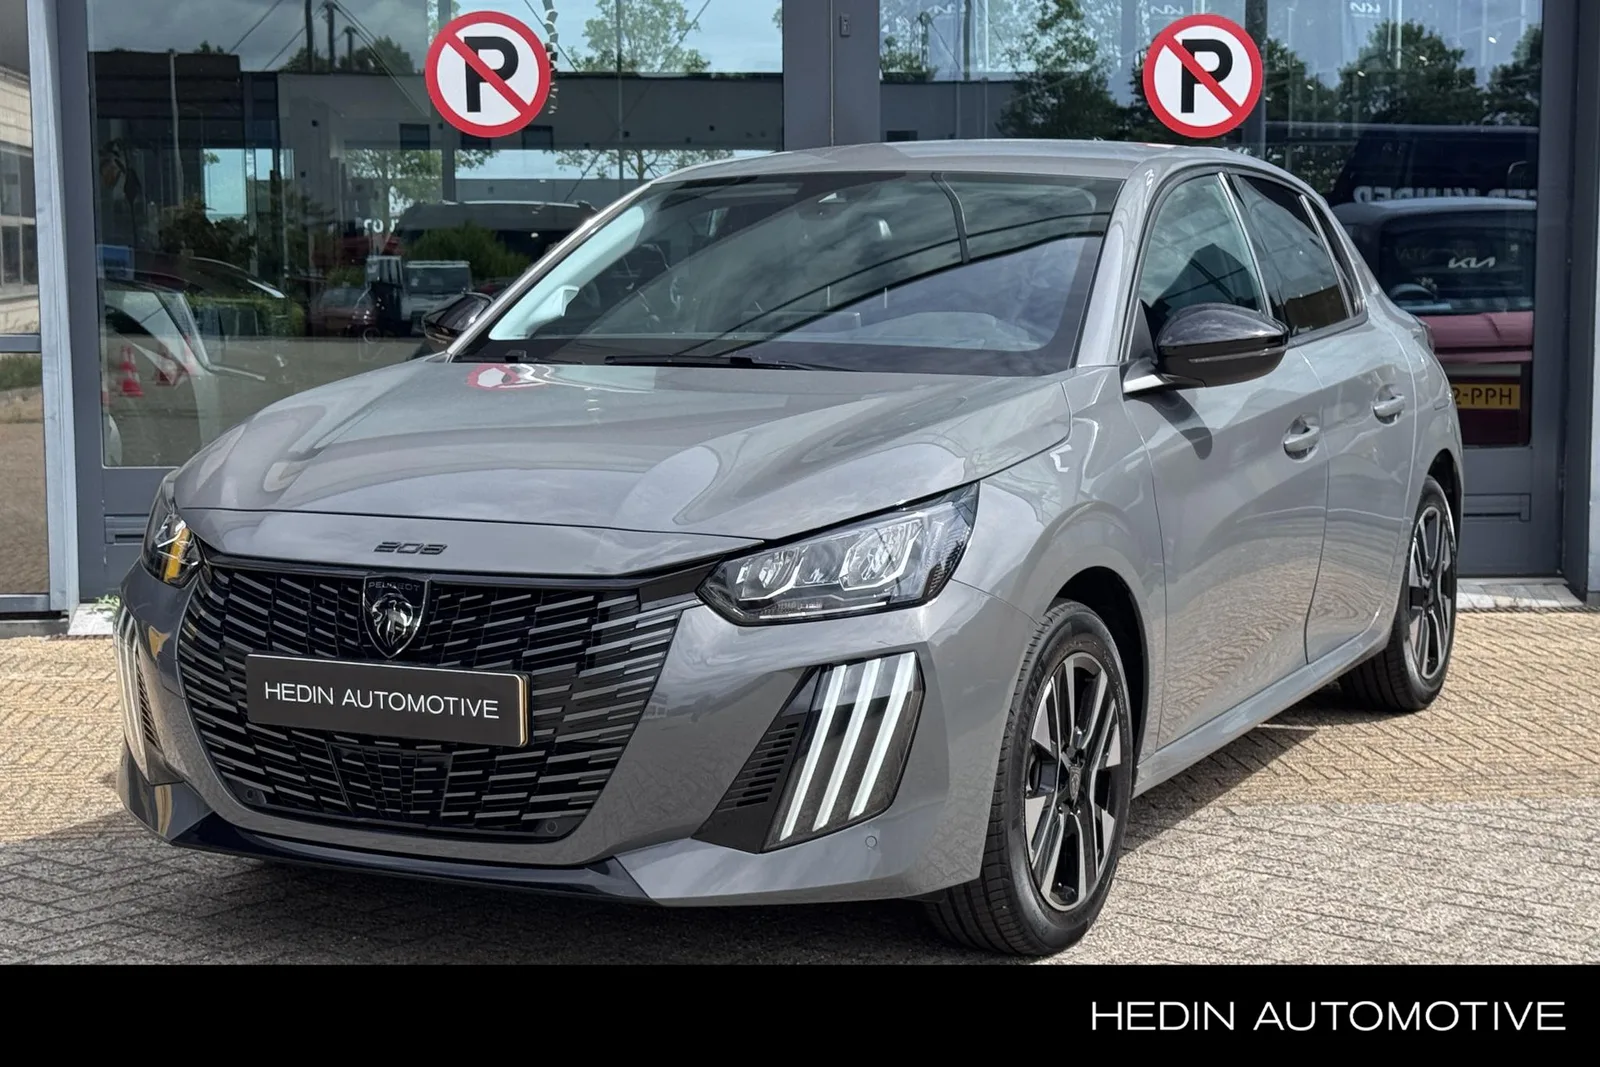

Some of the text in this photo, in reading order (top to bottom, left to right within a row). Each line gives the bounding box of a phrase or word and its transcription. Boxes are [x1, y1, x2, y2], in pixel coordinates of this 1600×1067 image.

[463, 36, 519, 113] P
[1180, 38, 1233, 114] P
[373, 541, 449, 556] 208
[264, 681, 500, 720] HEDIN AUTOMOTIVE
